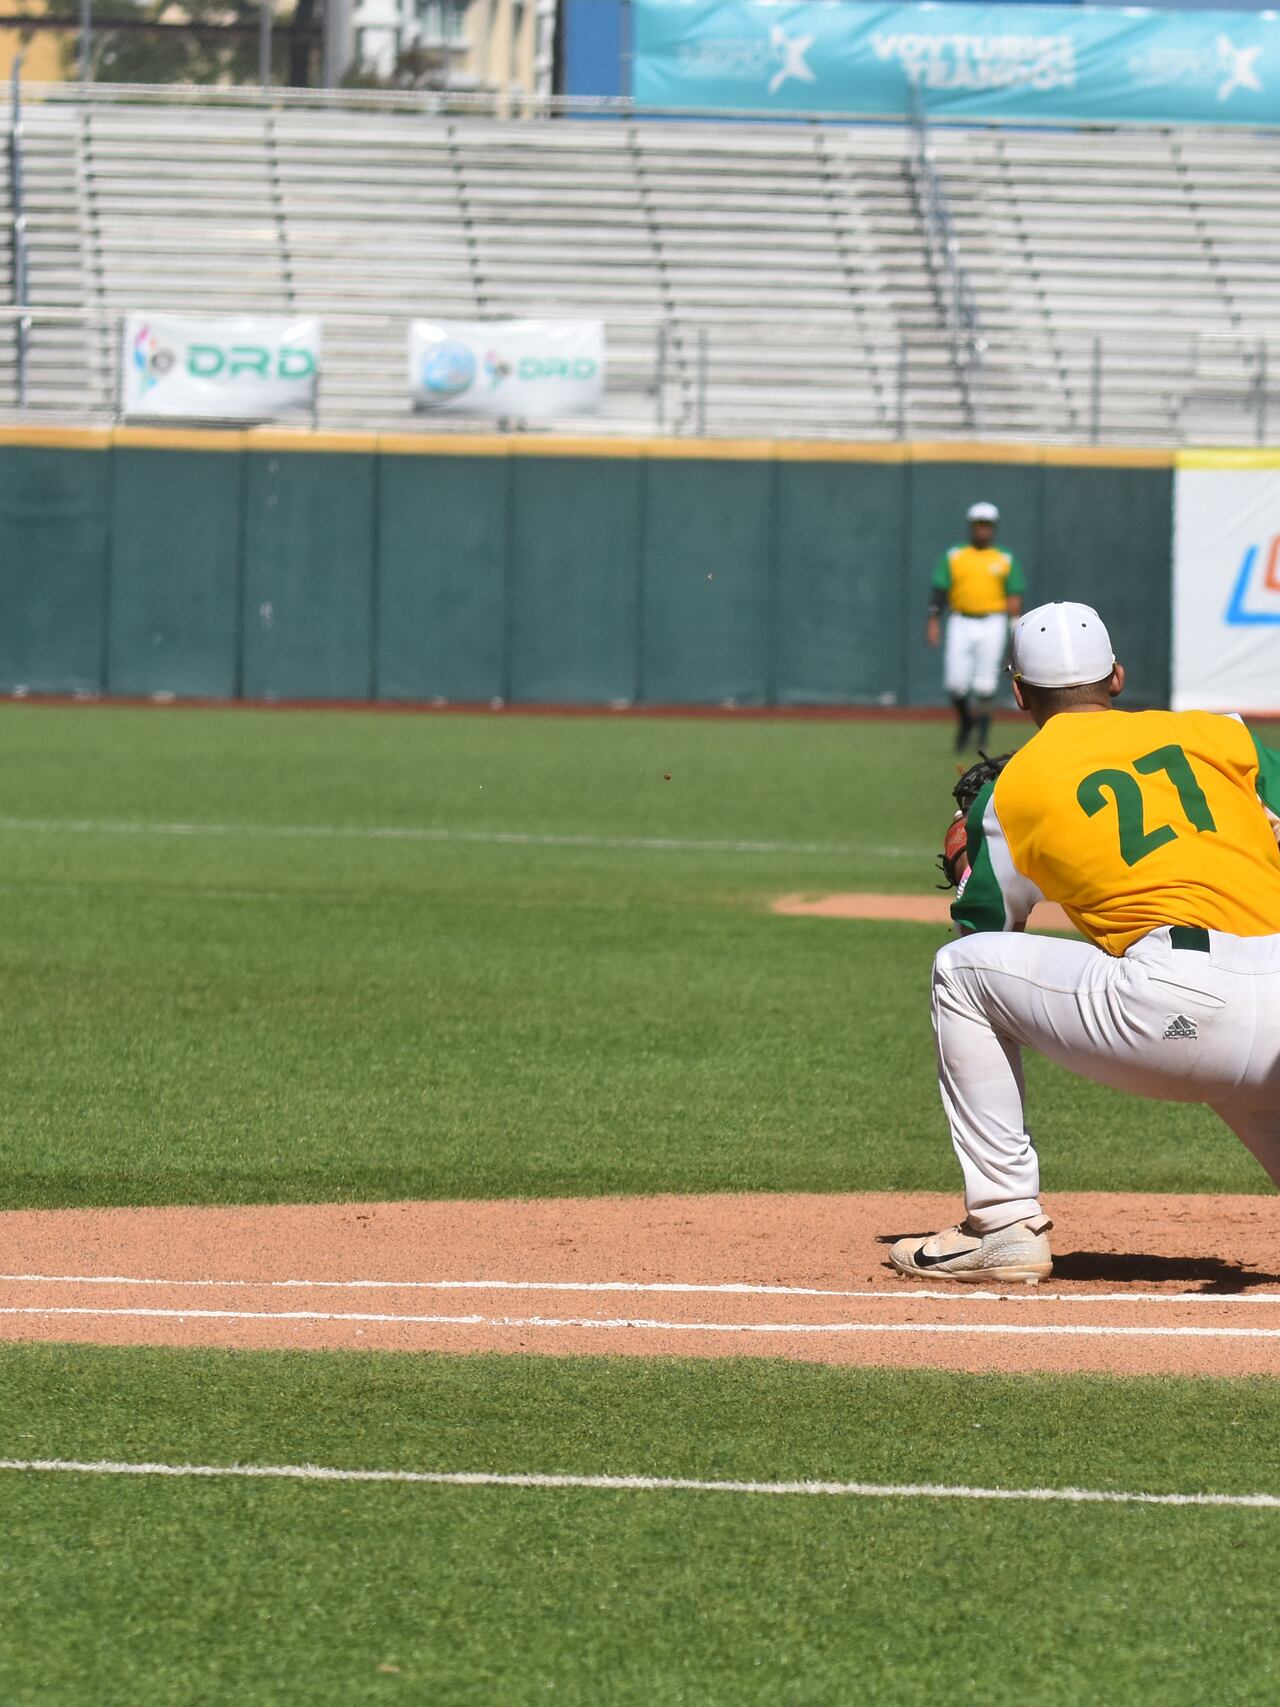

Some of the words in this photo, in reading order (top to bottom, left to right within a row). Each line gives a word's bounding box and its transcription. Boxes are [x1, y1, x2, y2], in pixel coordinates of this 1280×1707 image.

[186, 347, 316, 379] DRD
[518, 357, 596, 380] DRD
[1076, 744, 1216, 867] 27
[1164, 1029, 1196, 1037] adidas
